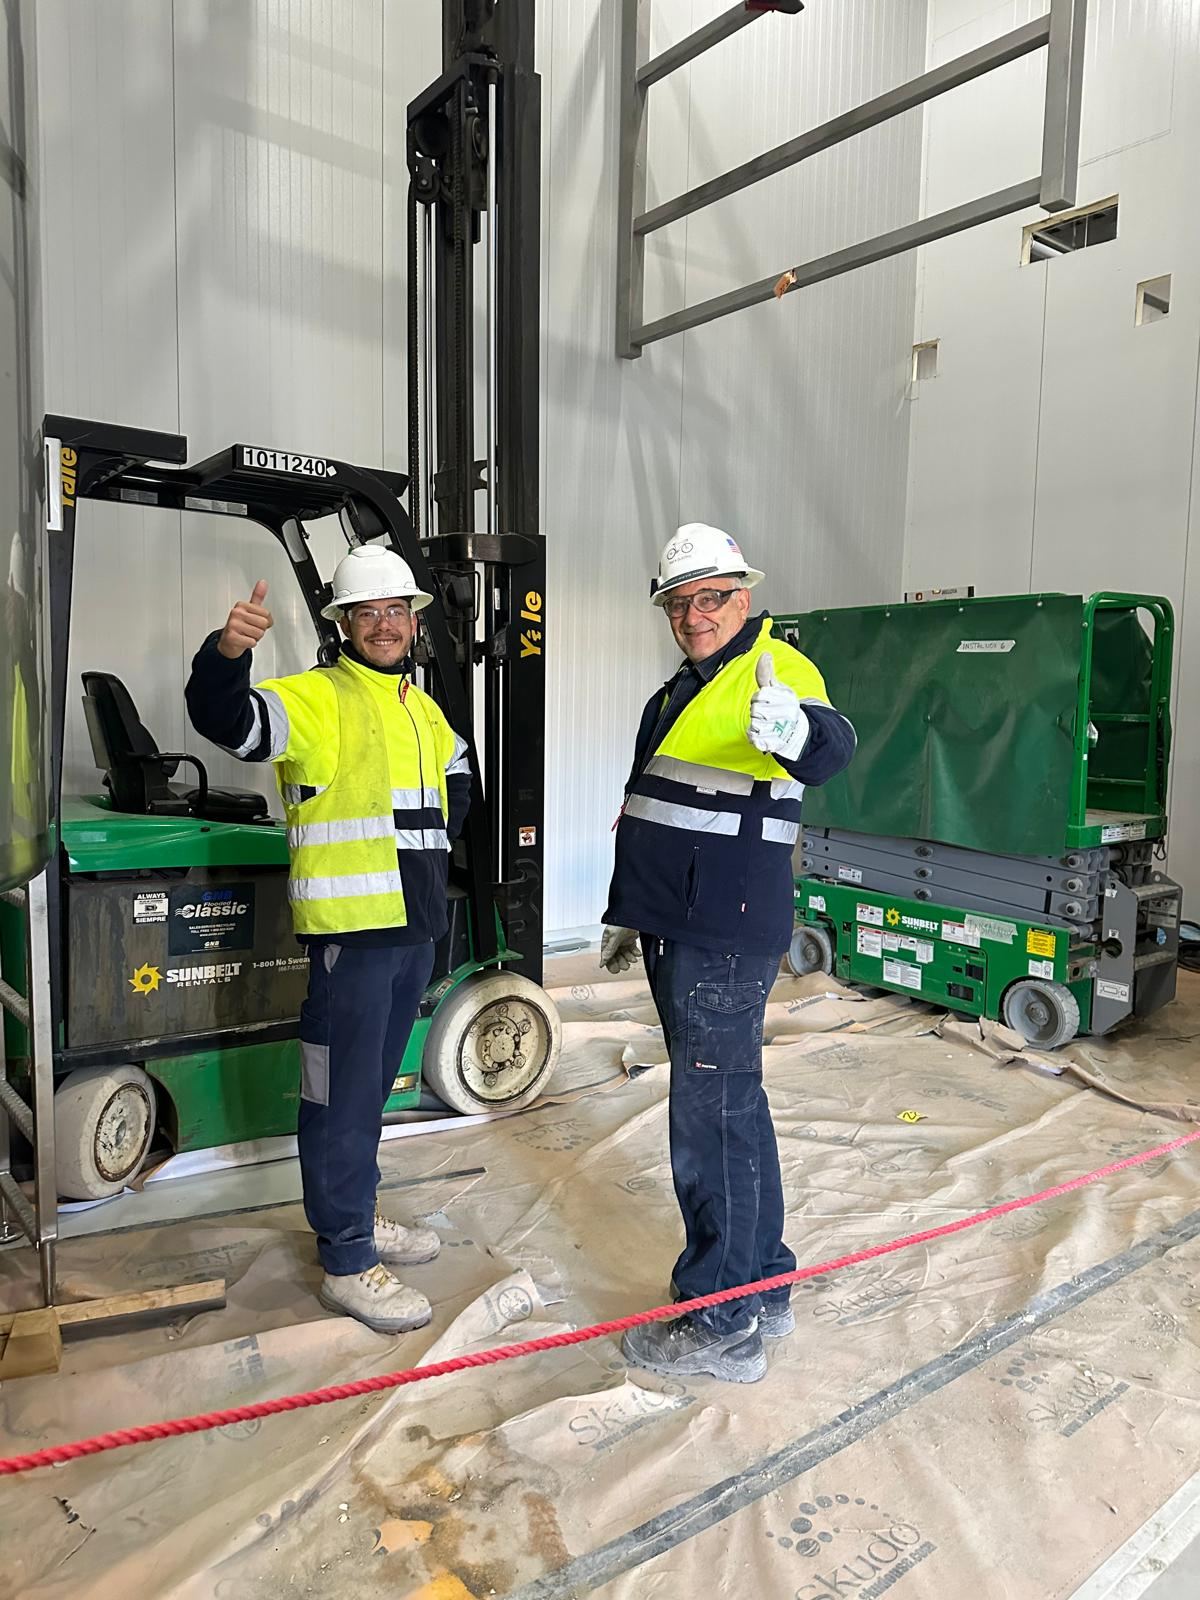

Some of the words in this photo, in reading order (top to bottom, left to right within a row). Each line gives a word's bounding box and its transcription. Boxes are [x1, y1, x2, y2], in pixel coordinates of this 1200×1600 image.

[245, 449, 325, 476] 1011240
[136, 892, 166, 900] ALWAYS
[182, 902, 248, 919] Classic
[901, 915, 939, 931] SUNBELT
[252, 960, 275, 969] 1-800
[276, 958, 287, 966] No
[166, 962, 243, 983] SUNBELT
[177, 976, 231, 988] RENTALS
